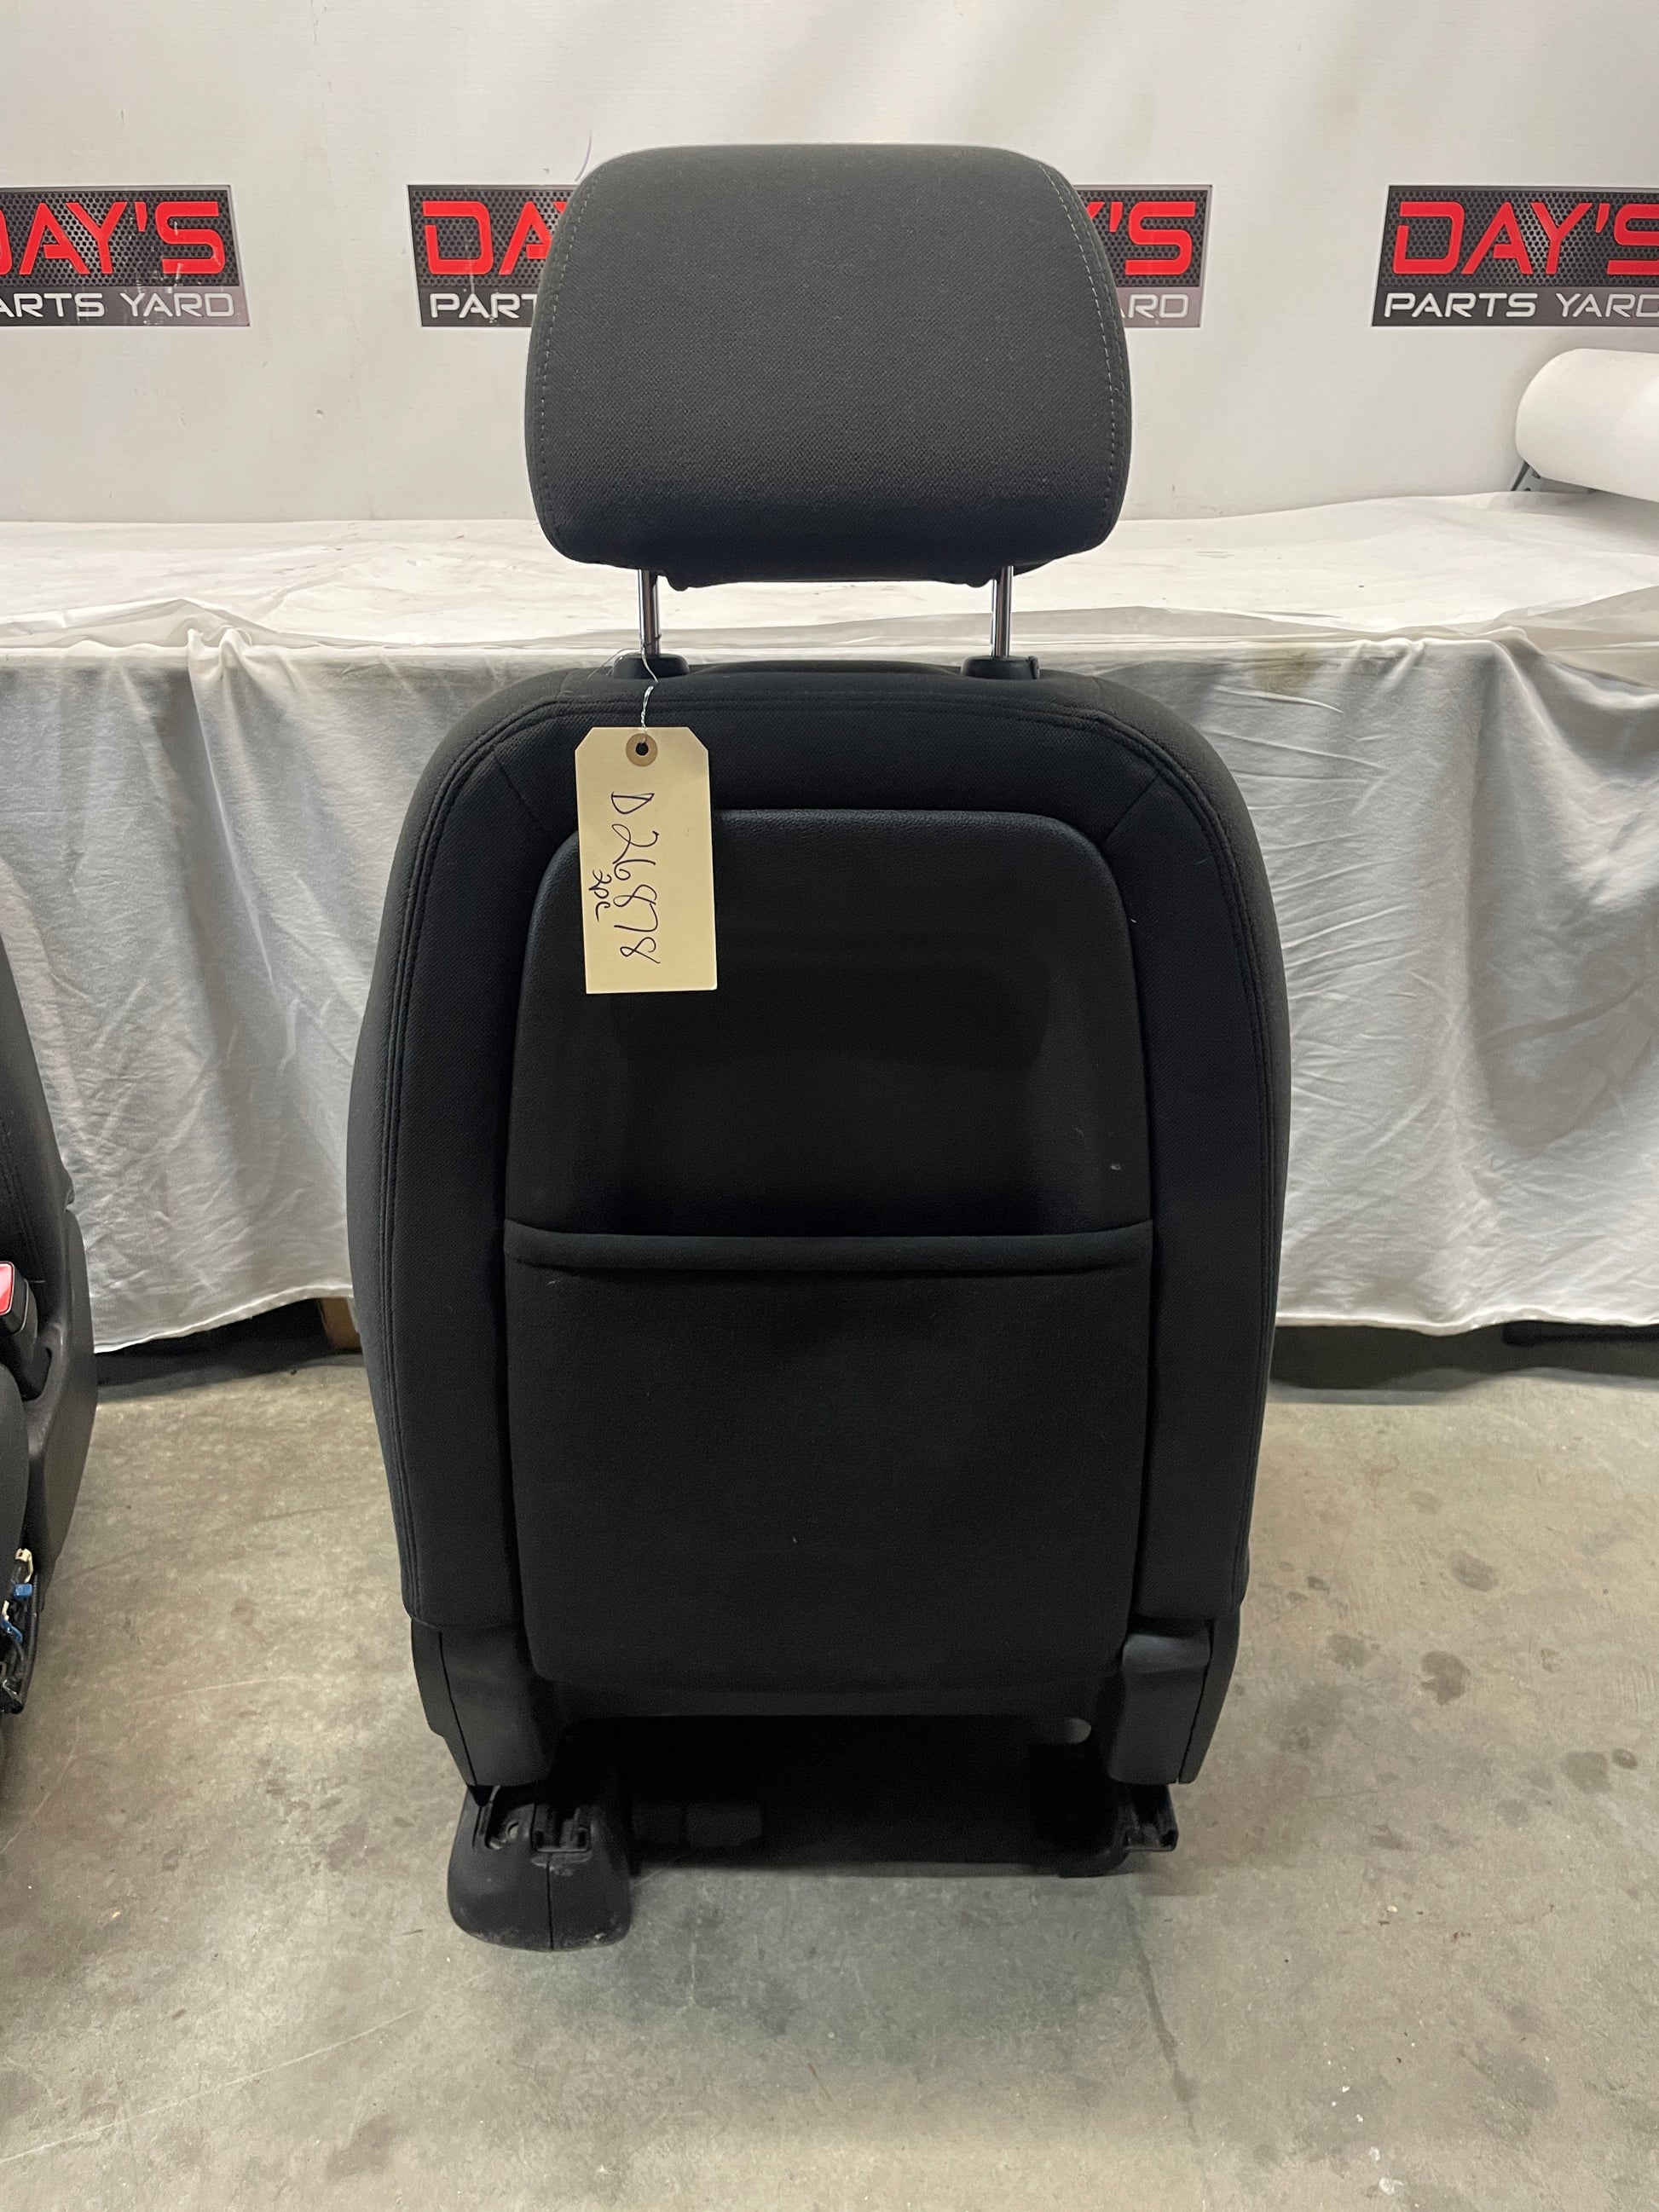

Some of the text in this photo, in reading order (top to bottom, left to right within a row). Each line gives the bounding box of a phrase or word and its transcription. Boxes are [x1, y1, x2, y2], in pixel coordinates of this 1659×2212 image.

[0, 201, 226, 275] AY'S
[422, 200, 568, 275] DA
[1086, 201, 1196, 275] 'S
[1392, 201, 1659, 275] DAY'S
[119, 292, 234, 318] YARD
[1119, 293, 1189, 319] RD
[1384, 292, 1659, 319] PARTS YARD
